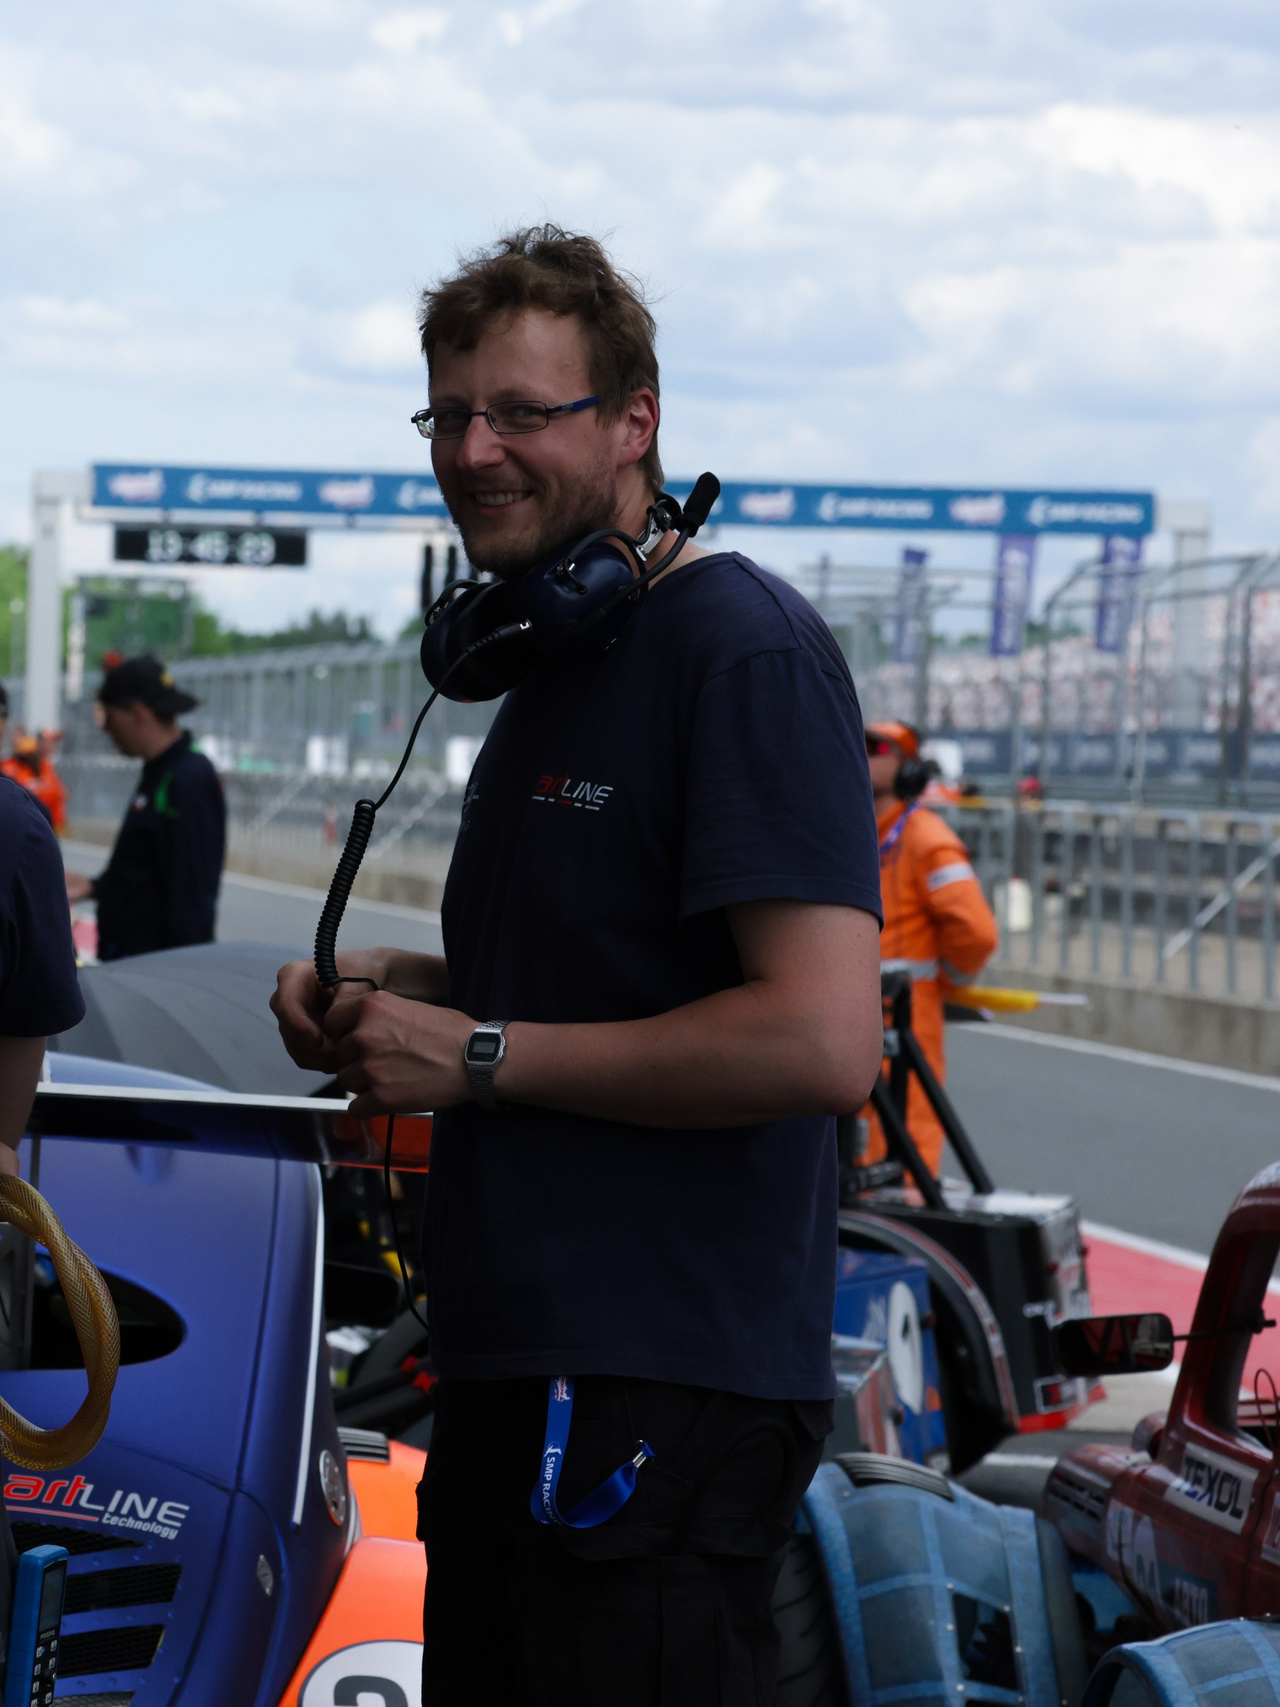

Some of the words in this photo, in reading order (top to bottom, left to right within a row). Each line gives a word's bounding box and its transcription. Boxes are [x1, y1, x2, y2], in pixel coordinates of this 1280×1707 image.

[535, 773, 614, 804] artLINE
[543, 1457, 556, 1481] SMP
[3, 1474, 190, 1528] artLINE
[1177, 1457, 1244, 1520] TEXOL
[102, 1512, 179, 1540] technology
